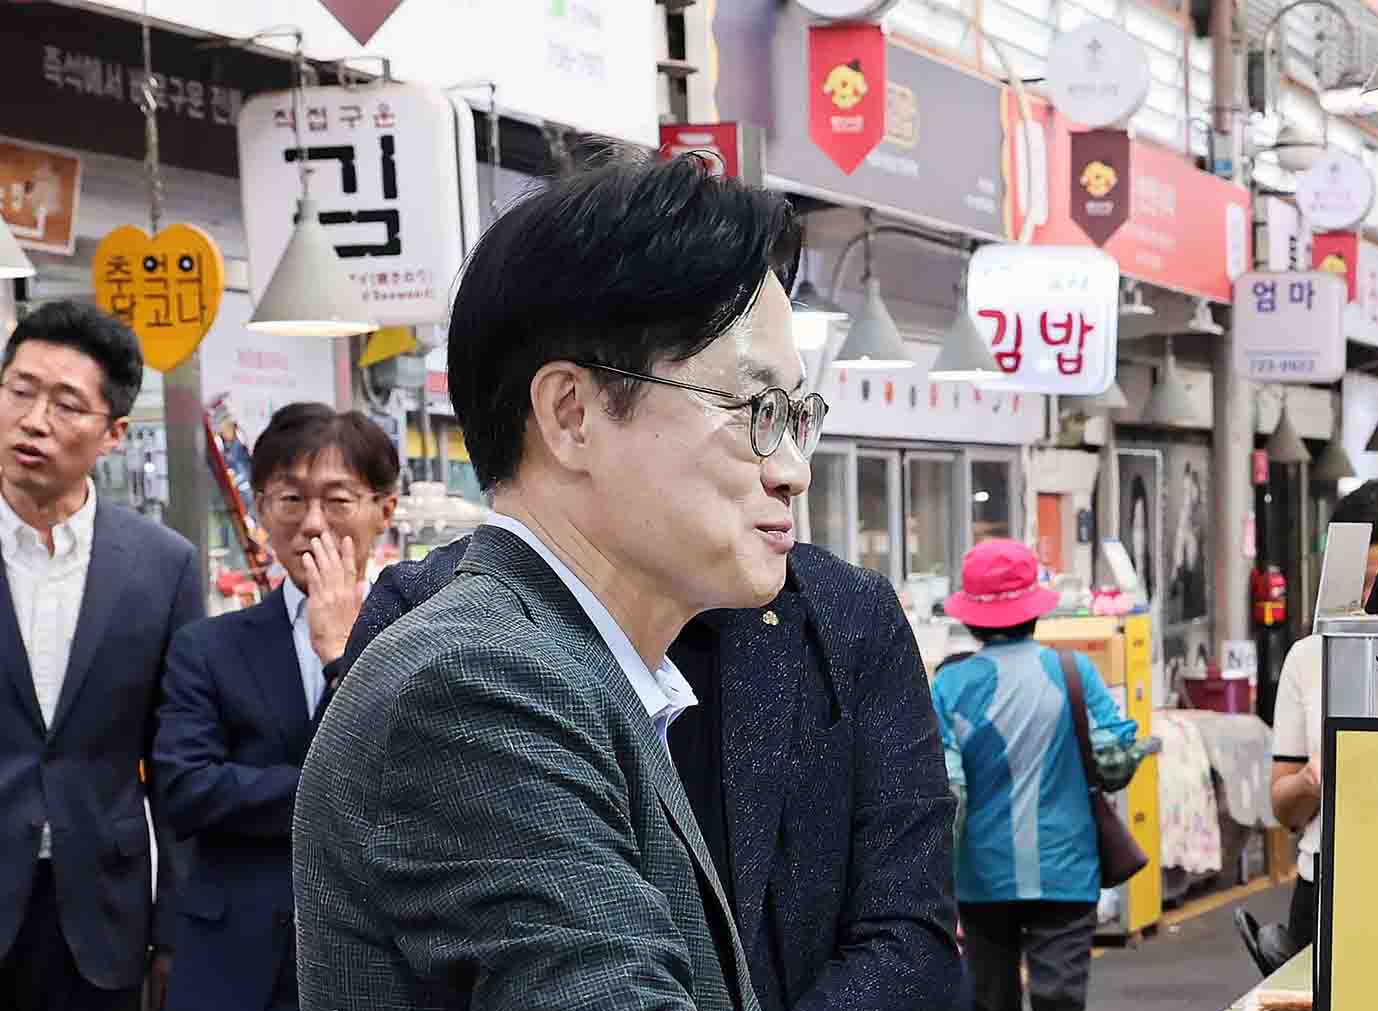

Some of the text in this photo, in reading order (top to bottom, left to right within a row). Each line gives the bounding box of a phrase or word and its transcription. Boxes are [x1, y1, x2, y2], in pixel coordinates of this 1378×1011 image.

[103, 252, 203, 292] 추억의
[1252, 279, 1316, 312] 엄마
[976, 309, 1095, 375] 김밥
